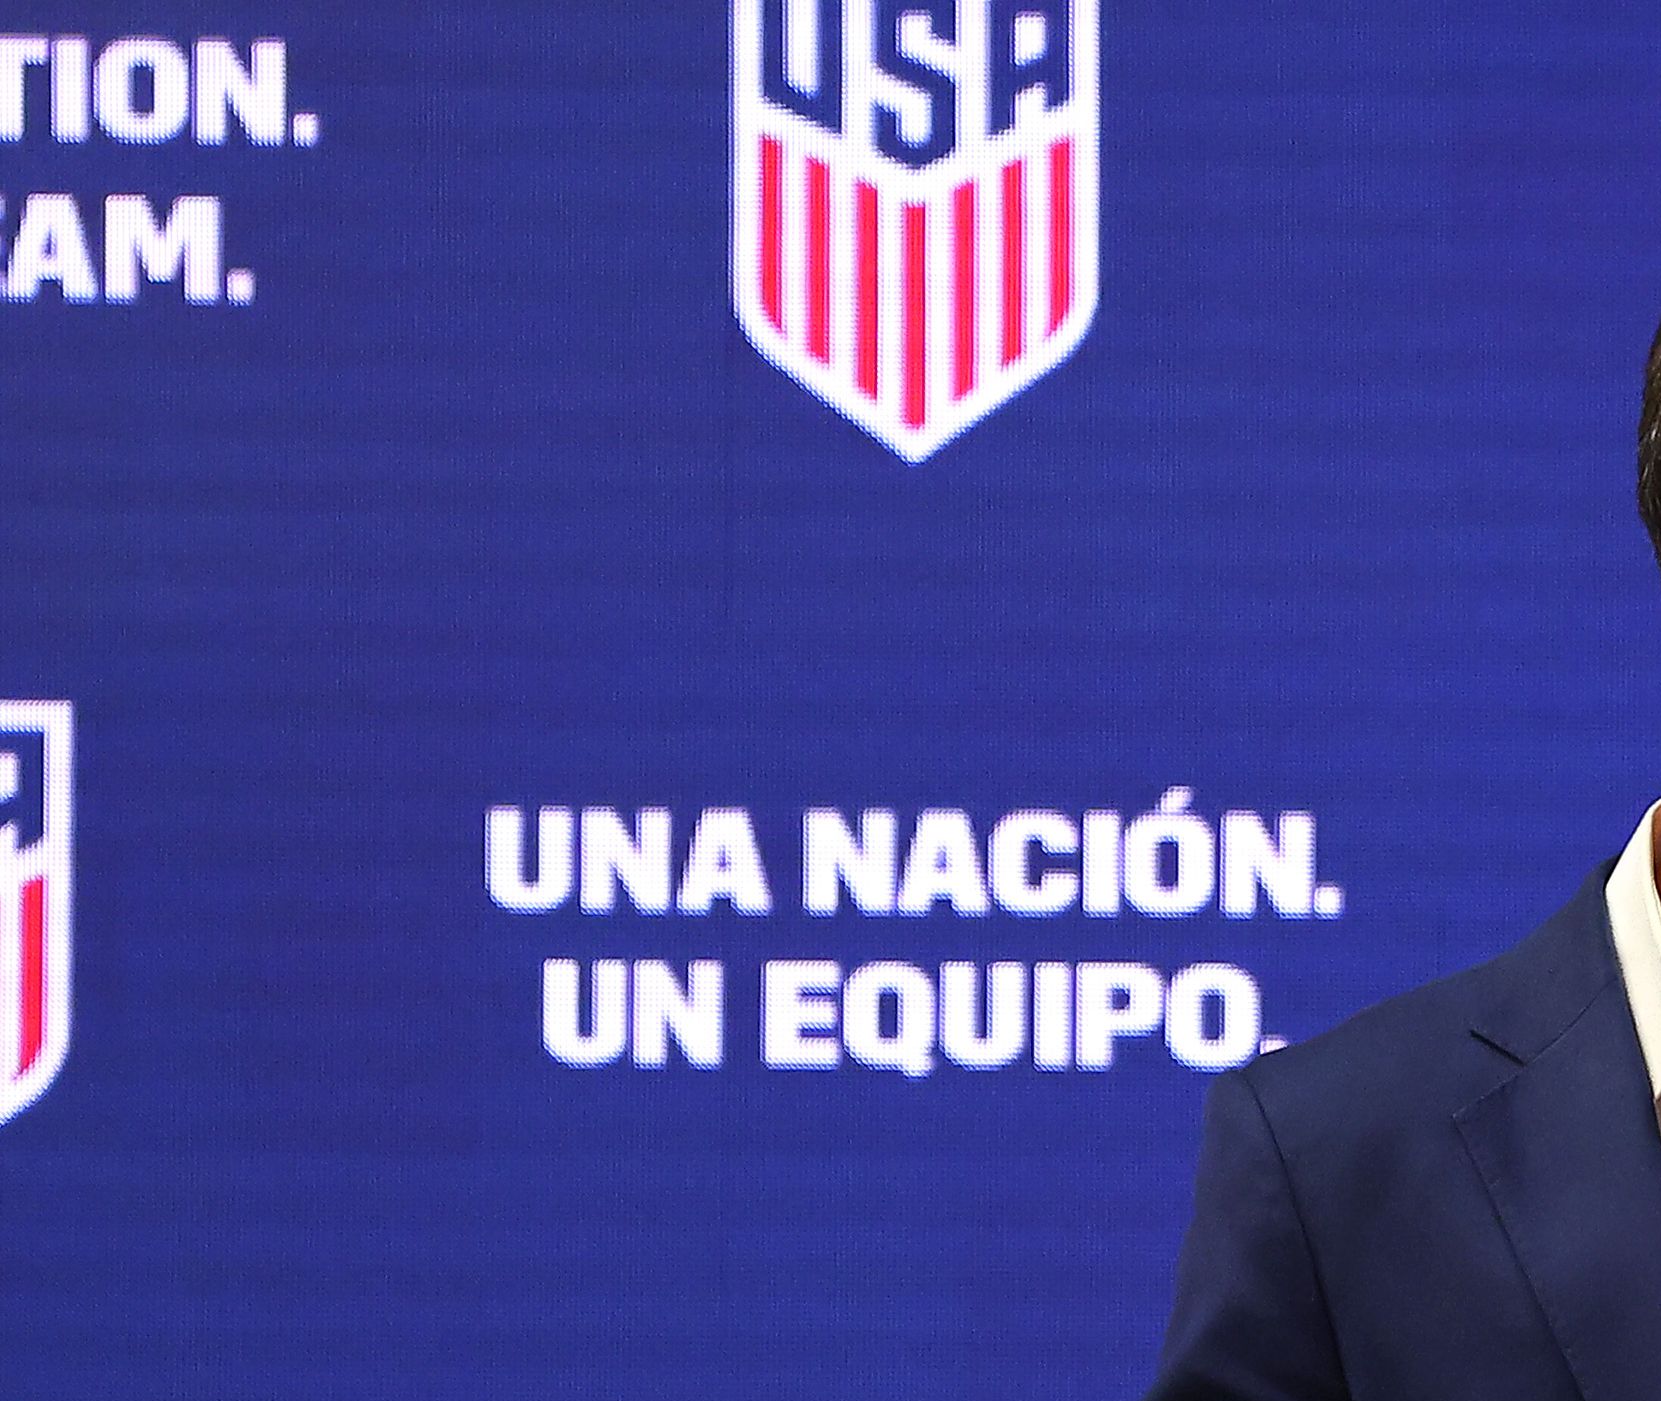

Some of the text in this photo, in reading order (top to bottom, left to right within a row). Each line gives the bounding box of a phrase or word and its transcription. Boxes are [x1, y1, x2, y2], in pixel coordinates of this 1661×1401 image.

[760, 0, 1070, 171] USA
[0, 192, 255, 306] AM.
[483, 784, 1344, 921] UNA NACIÓN.
[541, 957, 725, 1072] UN
